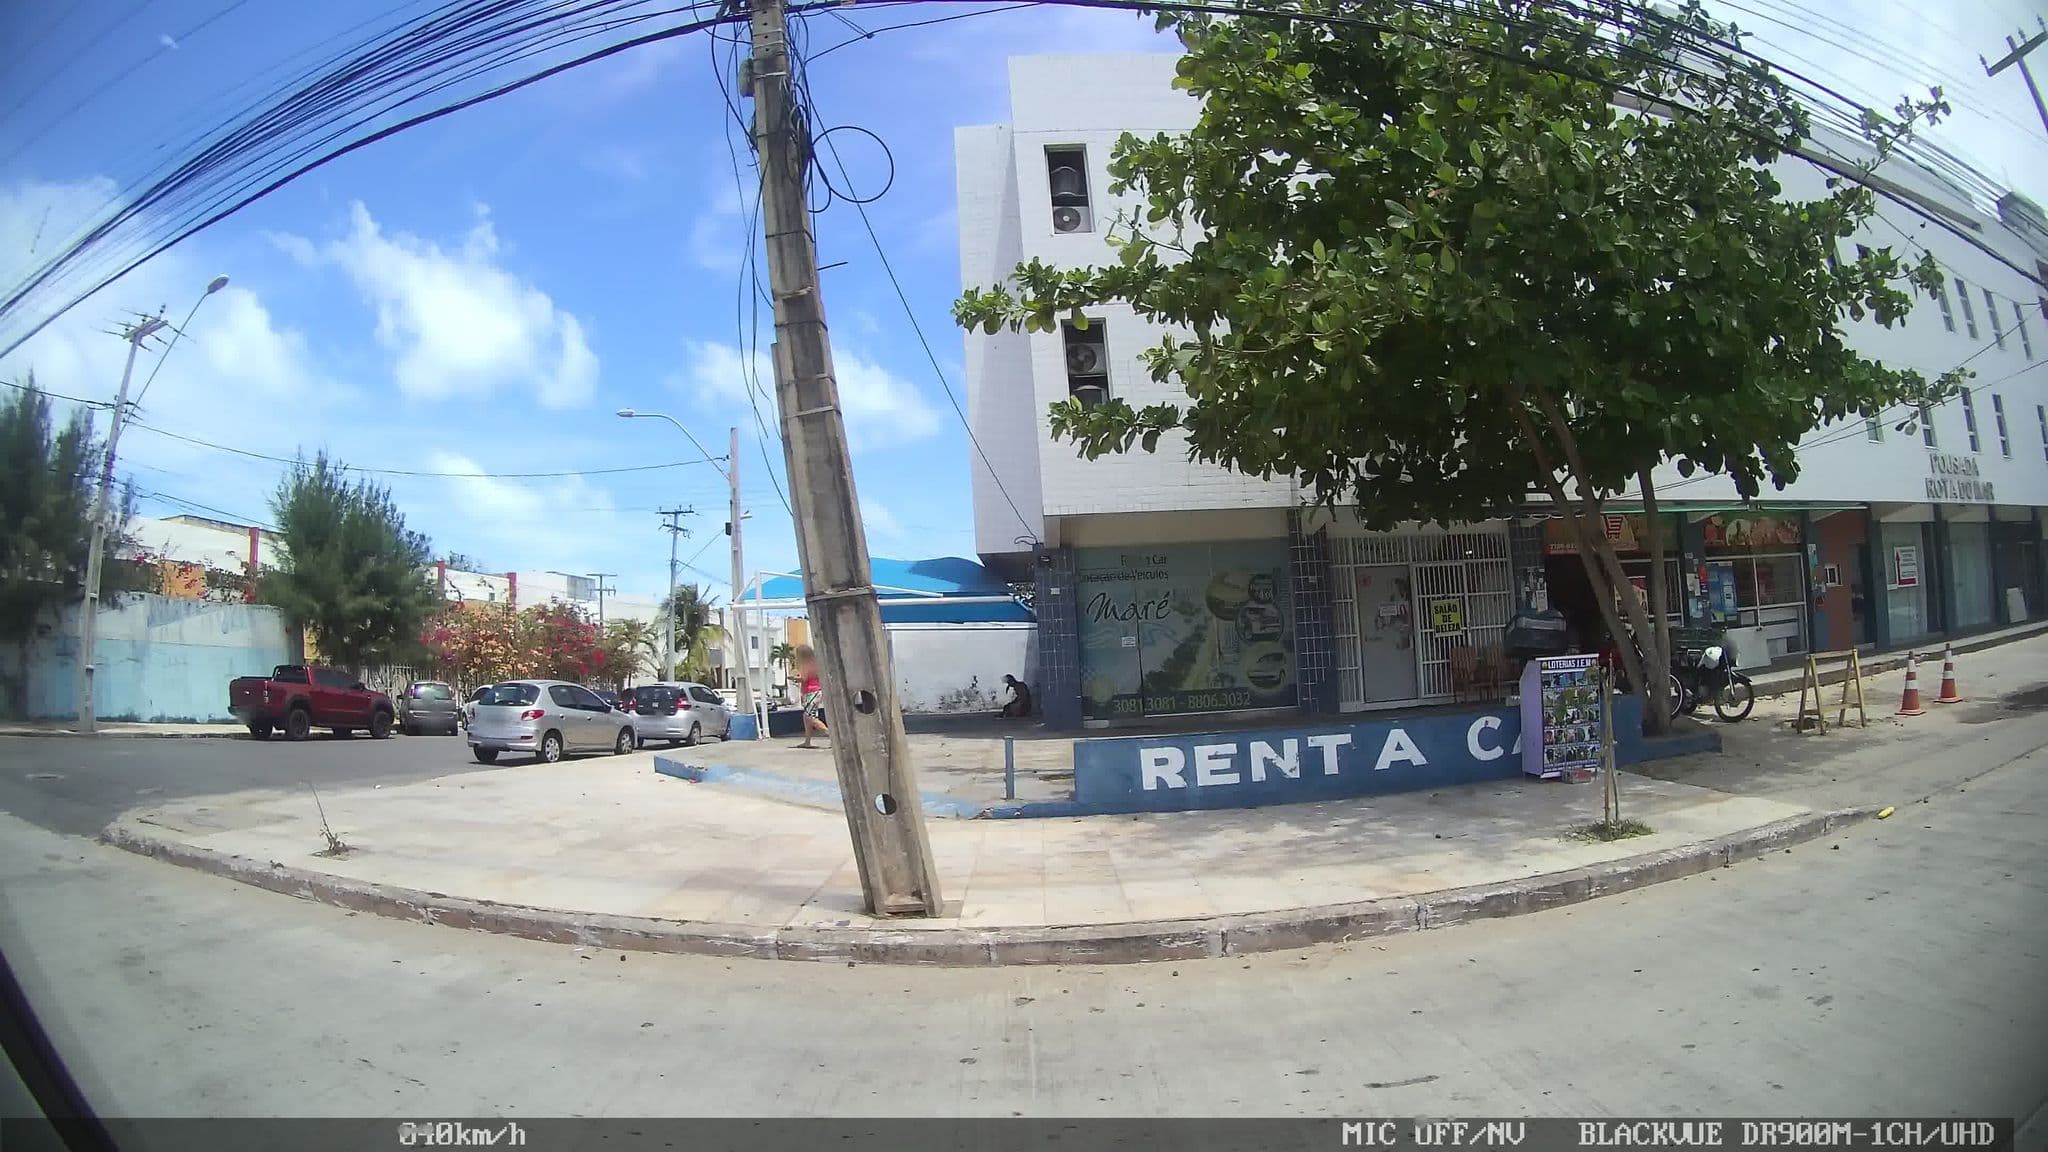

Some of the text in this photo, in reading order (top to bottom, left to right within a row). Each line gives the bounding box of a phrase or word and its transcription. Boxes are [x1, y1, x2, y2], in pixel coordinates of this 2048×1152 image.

[1929, 453, 1980, 477] POUSADA
[1086, 591, 1171, 623] Maré
[1442, 614, 1453, 624] DE
[1139, 733, 1352, 791] RENT
[1374, 728, 1429, 771] A
